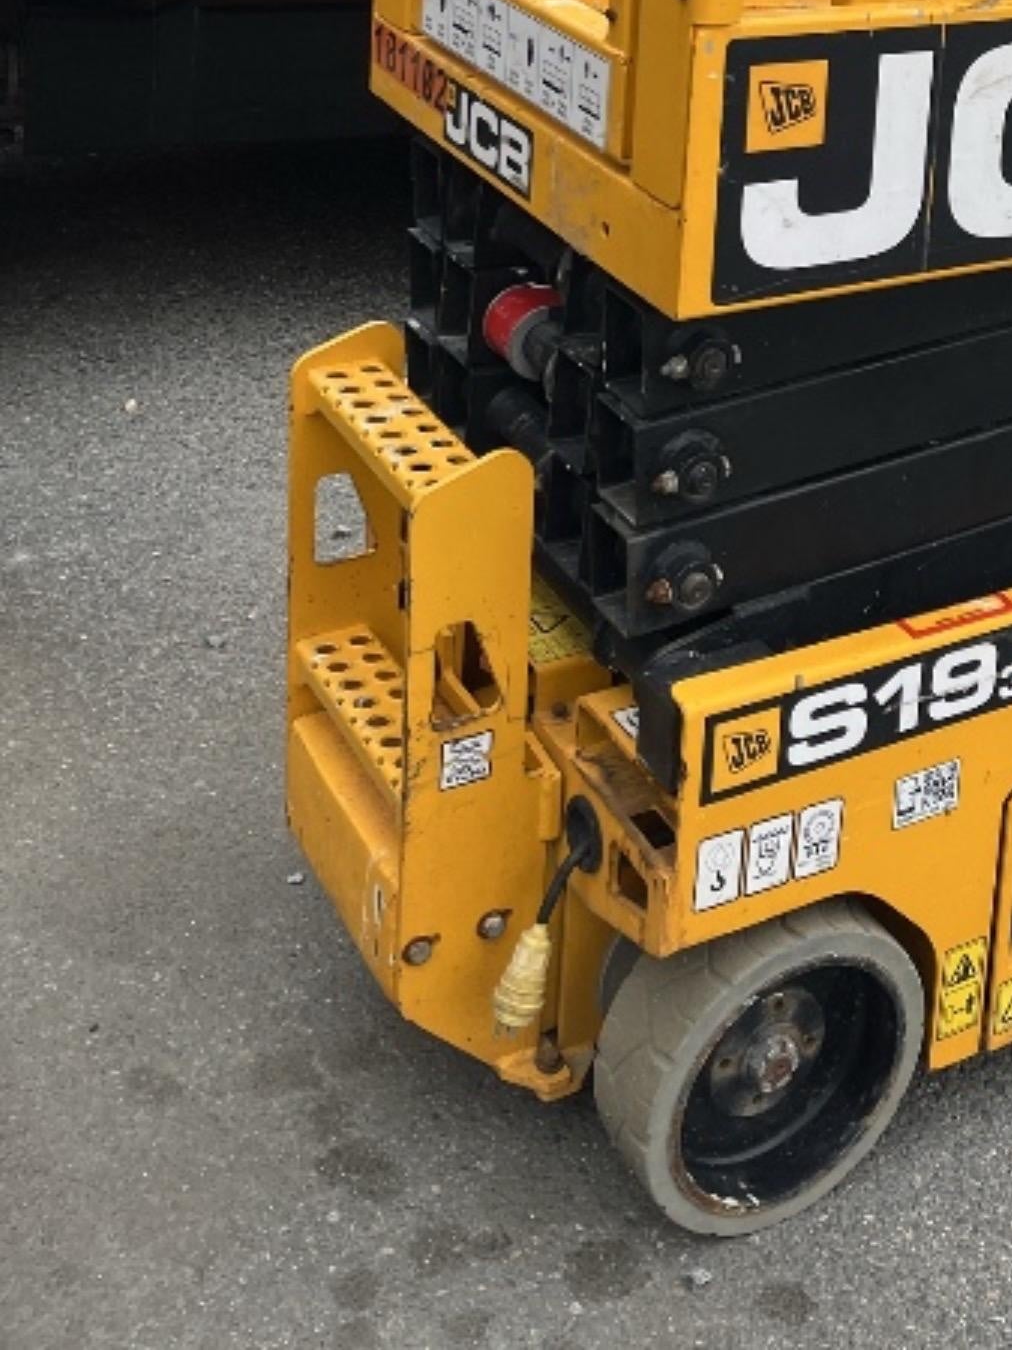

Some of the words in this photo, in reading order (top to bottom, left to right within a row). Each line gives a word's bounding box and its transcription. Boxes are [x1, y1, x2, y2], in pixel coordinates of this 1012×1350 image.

[768, 84, 815, 128] JCB
[445, 88, 533, 191] JCB
[730, 733, 770, 769] JCB
